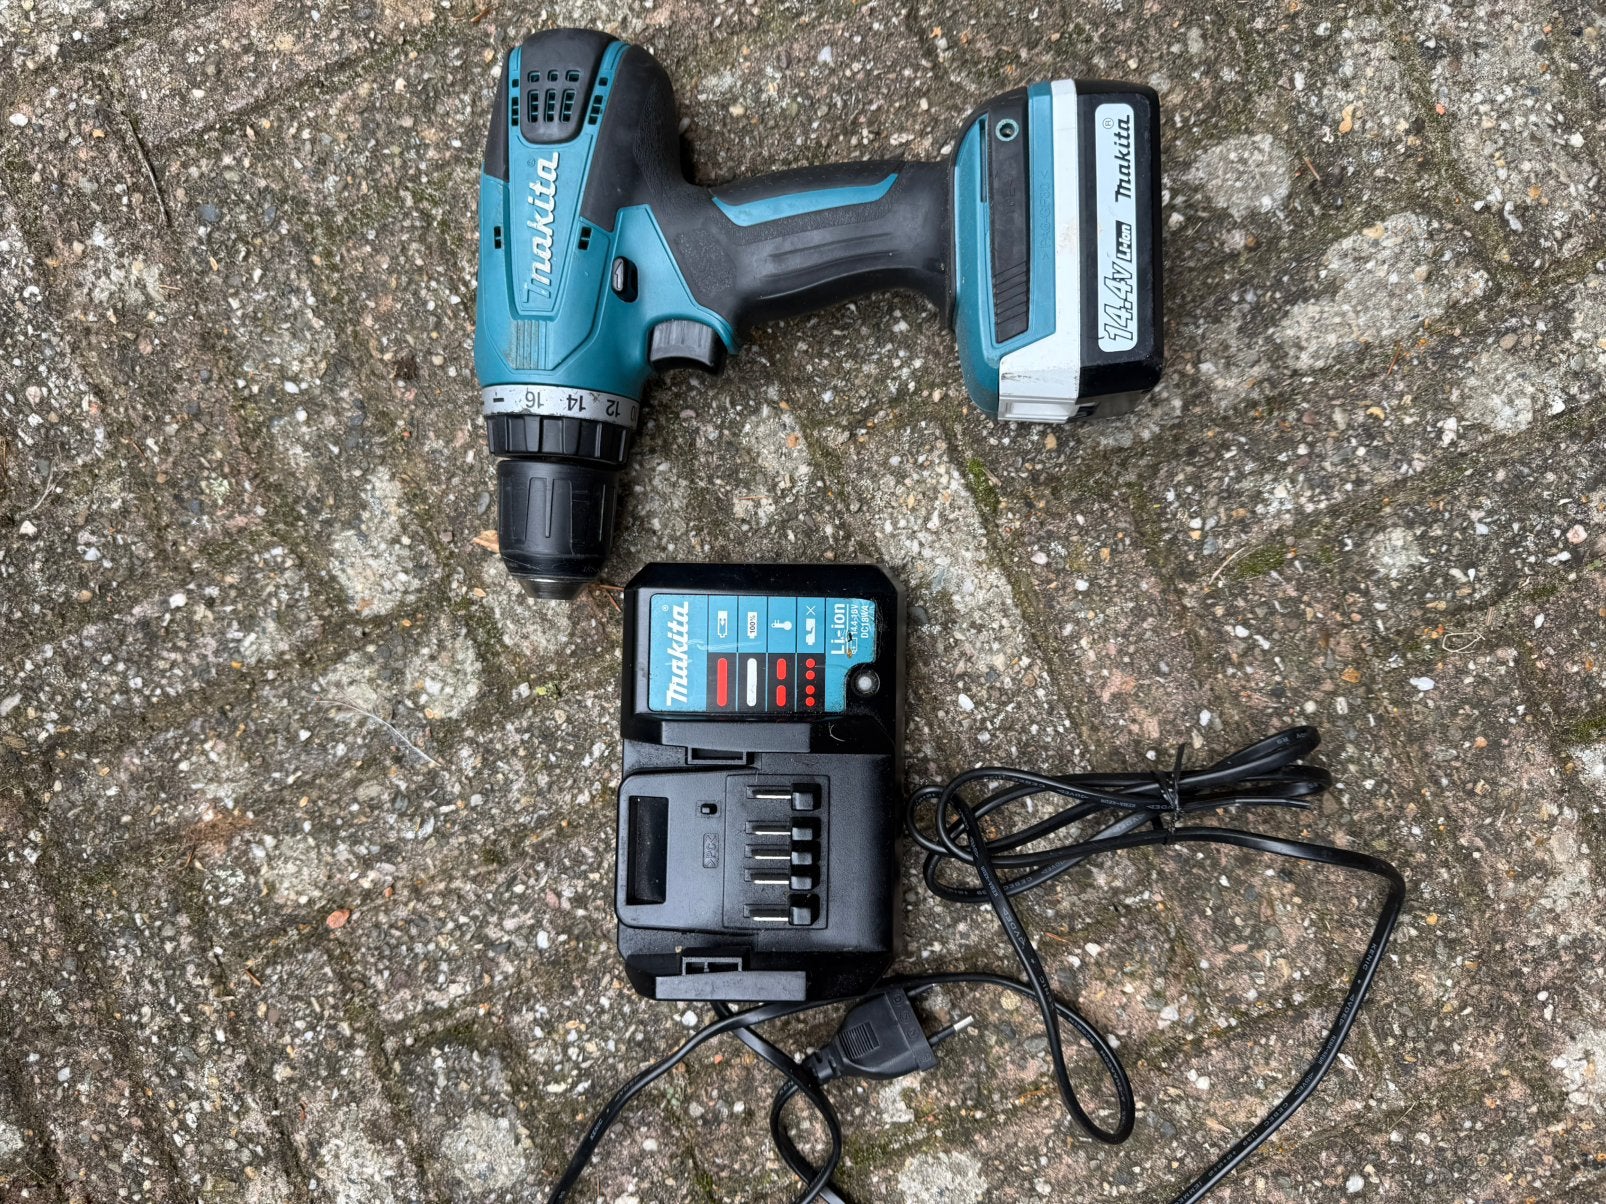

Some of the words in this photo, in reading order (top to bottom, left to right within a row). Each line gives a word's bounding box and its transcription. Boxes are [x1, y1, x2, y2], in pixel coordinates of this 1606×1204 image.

[1104, 262, 1134, 342] 14.4V
[525, 390, 544, 409] 16
[566, 394, 586, 412] 14
[606, 399, 621, 417] 12
[831, 603, 845, 654] Li-ion
[861, 605, 869, 639] DC18WA
[1362, 943, 1377, 971] KENIC
